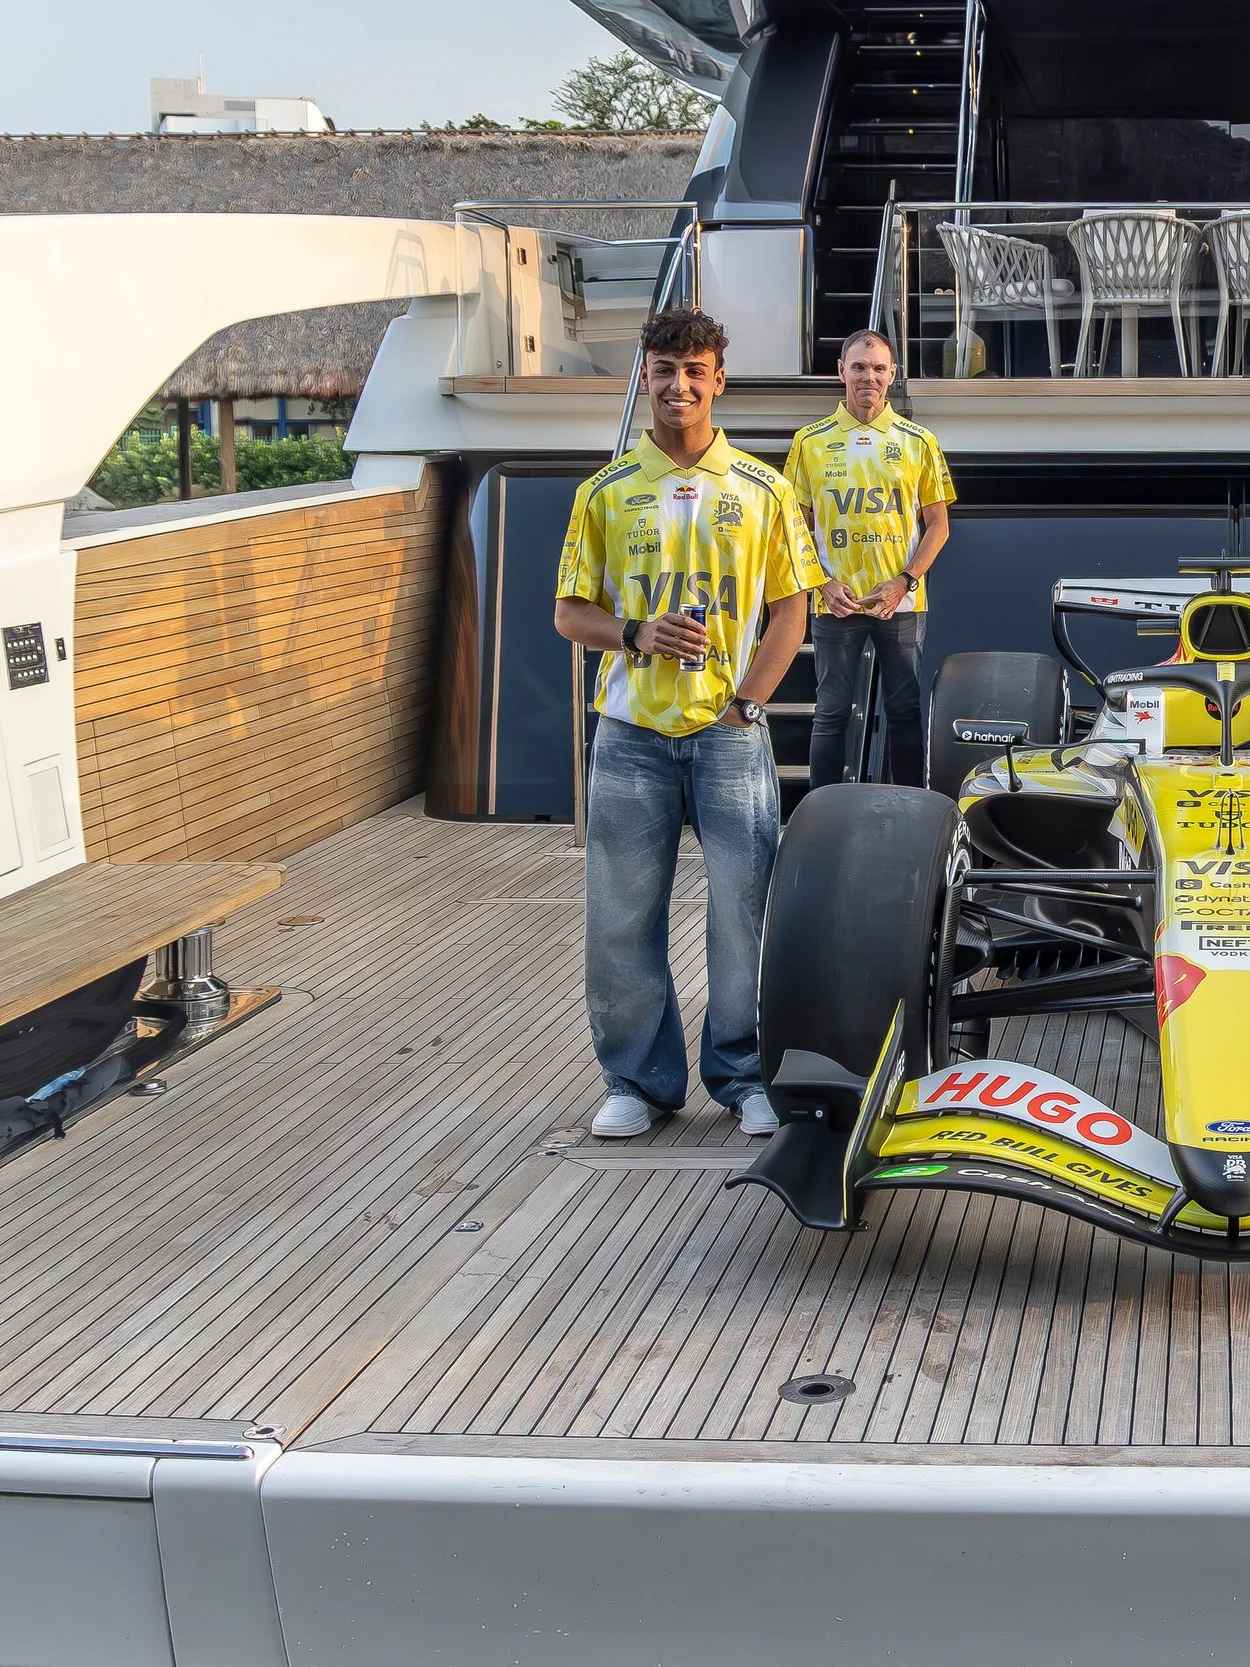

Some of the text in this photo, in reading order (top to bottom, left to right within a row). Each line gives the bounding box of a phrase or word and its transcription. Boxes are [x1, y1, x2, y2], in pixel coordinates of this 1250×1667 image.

[806, 418, 831, 432] HUGO
[900, 420, 925, 433] HUGO
[590, 460, 628, 486] HUGO
[736, 460, 776, 484] HUGO
[720, 492, 739, 501] VISA
[826, 487, 904, 515] VISA
[627, 528, 660, 539] TUDOR
[852, 531, 882, 543] Cash
[884, 532, 903, 544] App
[629, 542, 661, 556] Mobil
[629, 571, 737, 621] VISA
[1130, 700, 1160, 709] Mobil
[974, 731, 1015, 743] hahnair
[1210, 881, 1250, 889] Cash
[924, 1072, 1133, 1145] HUGO
[928, 1130, 1153, 1198] RED BULL GIVES
